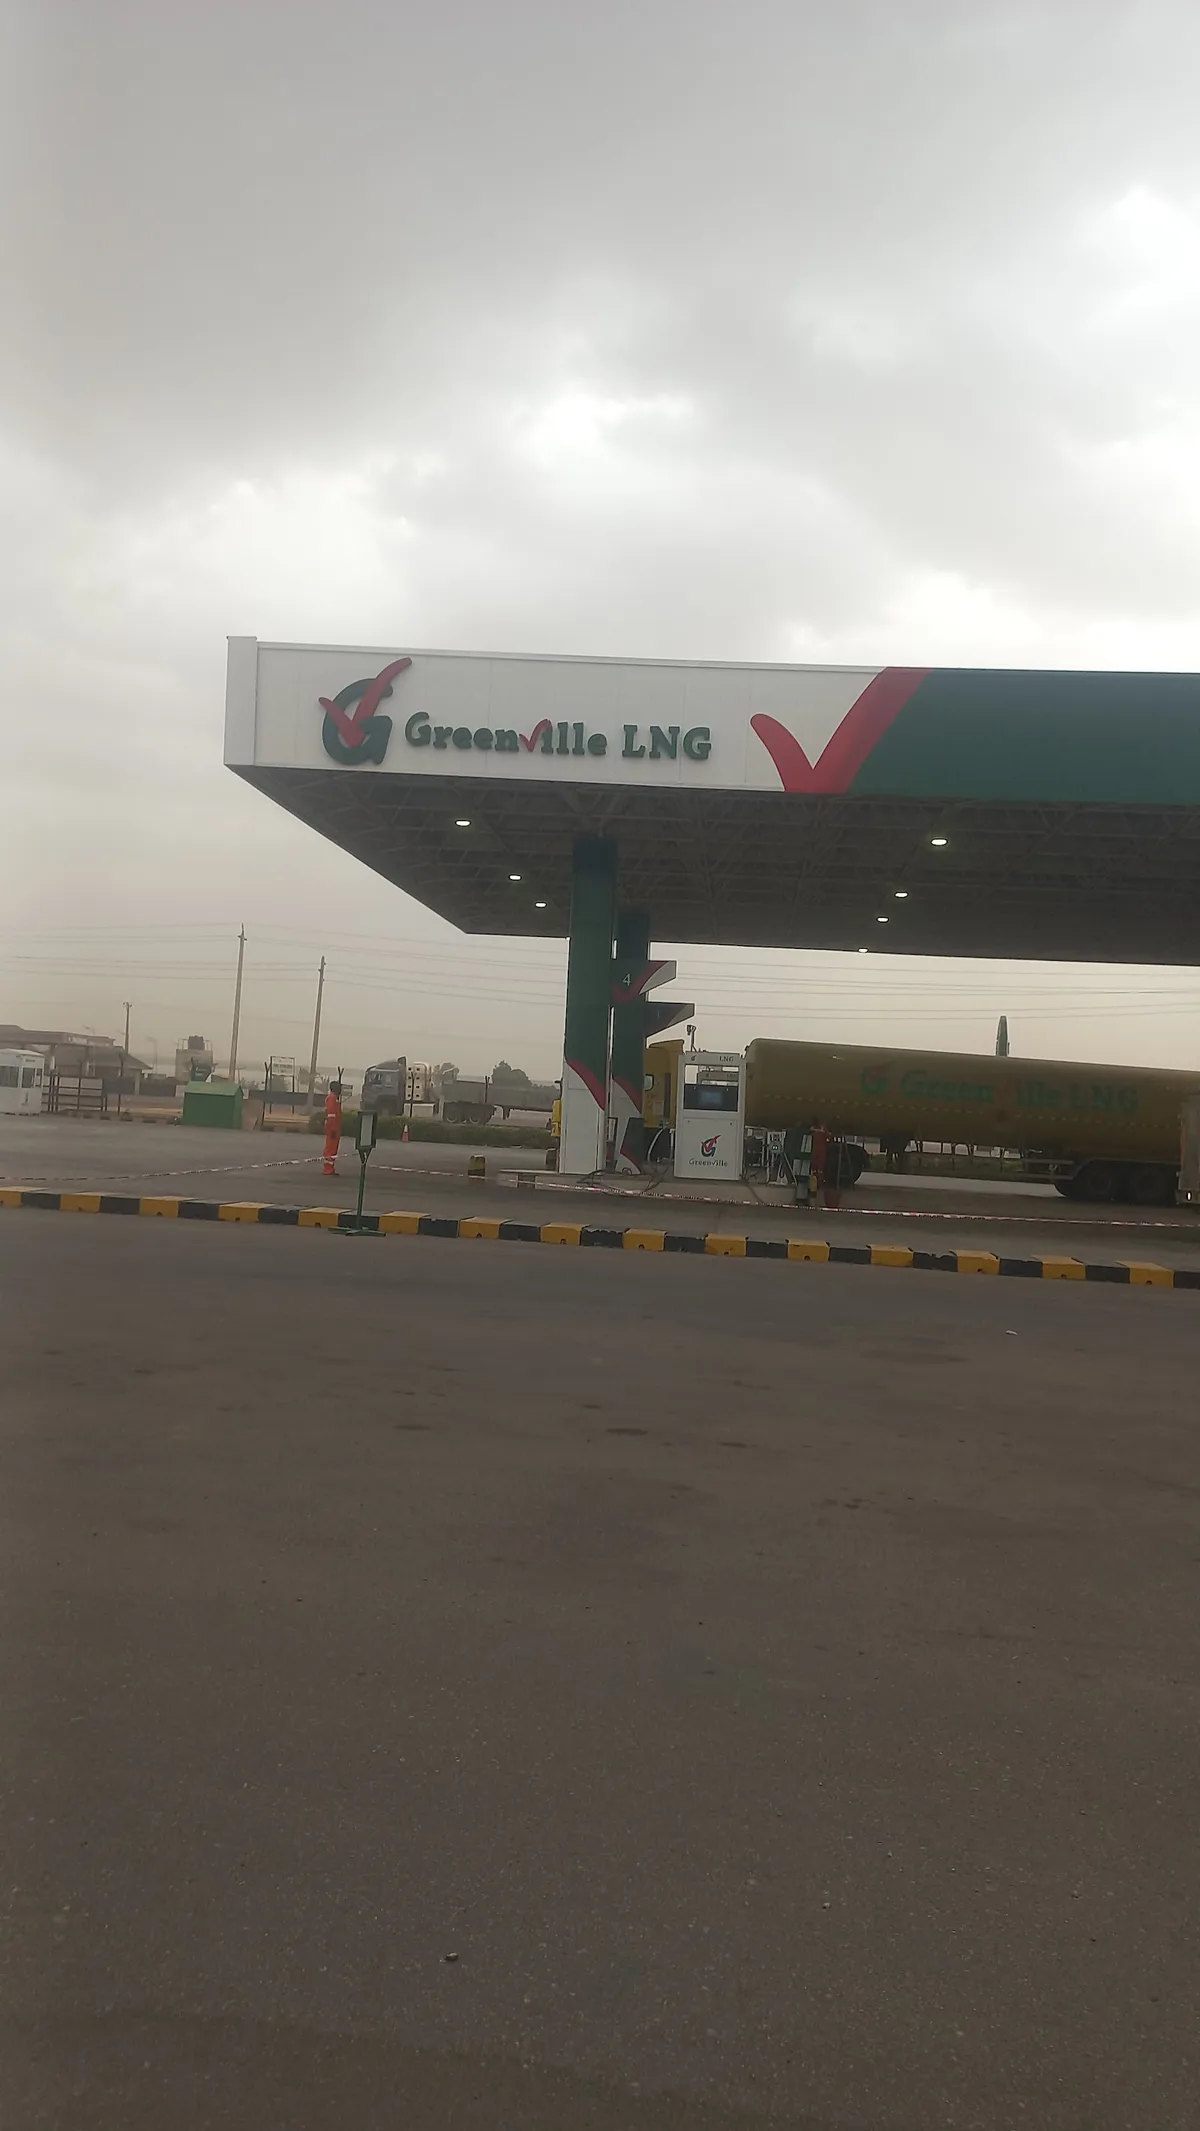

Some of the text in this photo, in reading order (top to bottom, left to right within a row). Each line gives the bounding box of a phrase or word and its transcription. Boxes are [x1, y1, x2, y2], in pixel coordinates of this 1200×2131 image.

[404, 711, 712, 760] Greenville LNG
[622, 973, 632, 987] 4
[688, 1157, 728, 1167] Greenville
